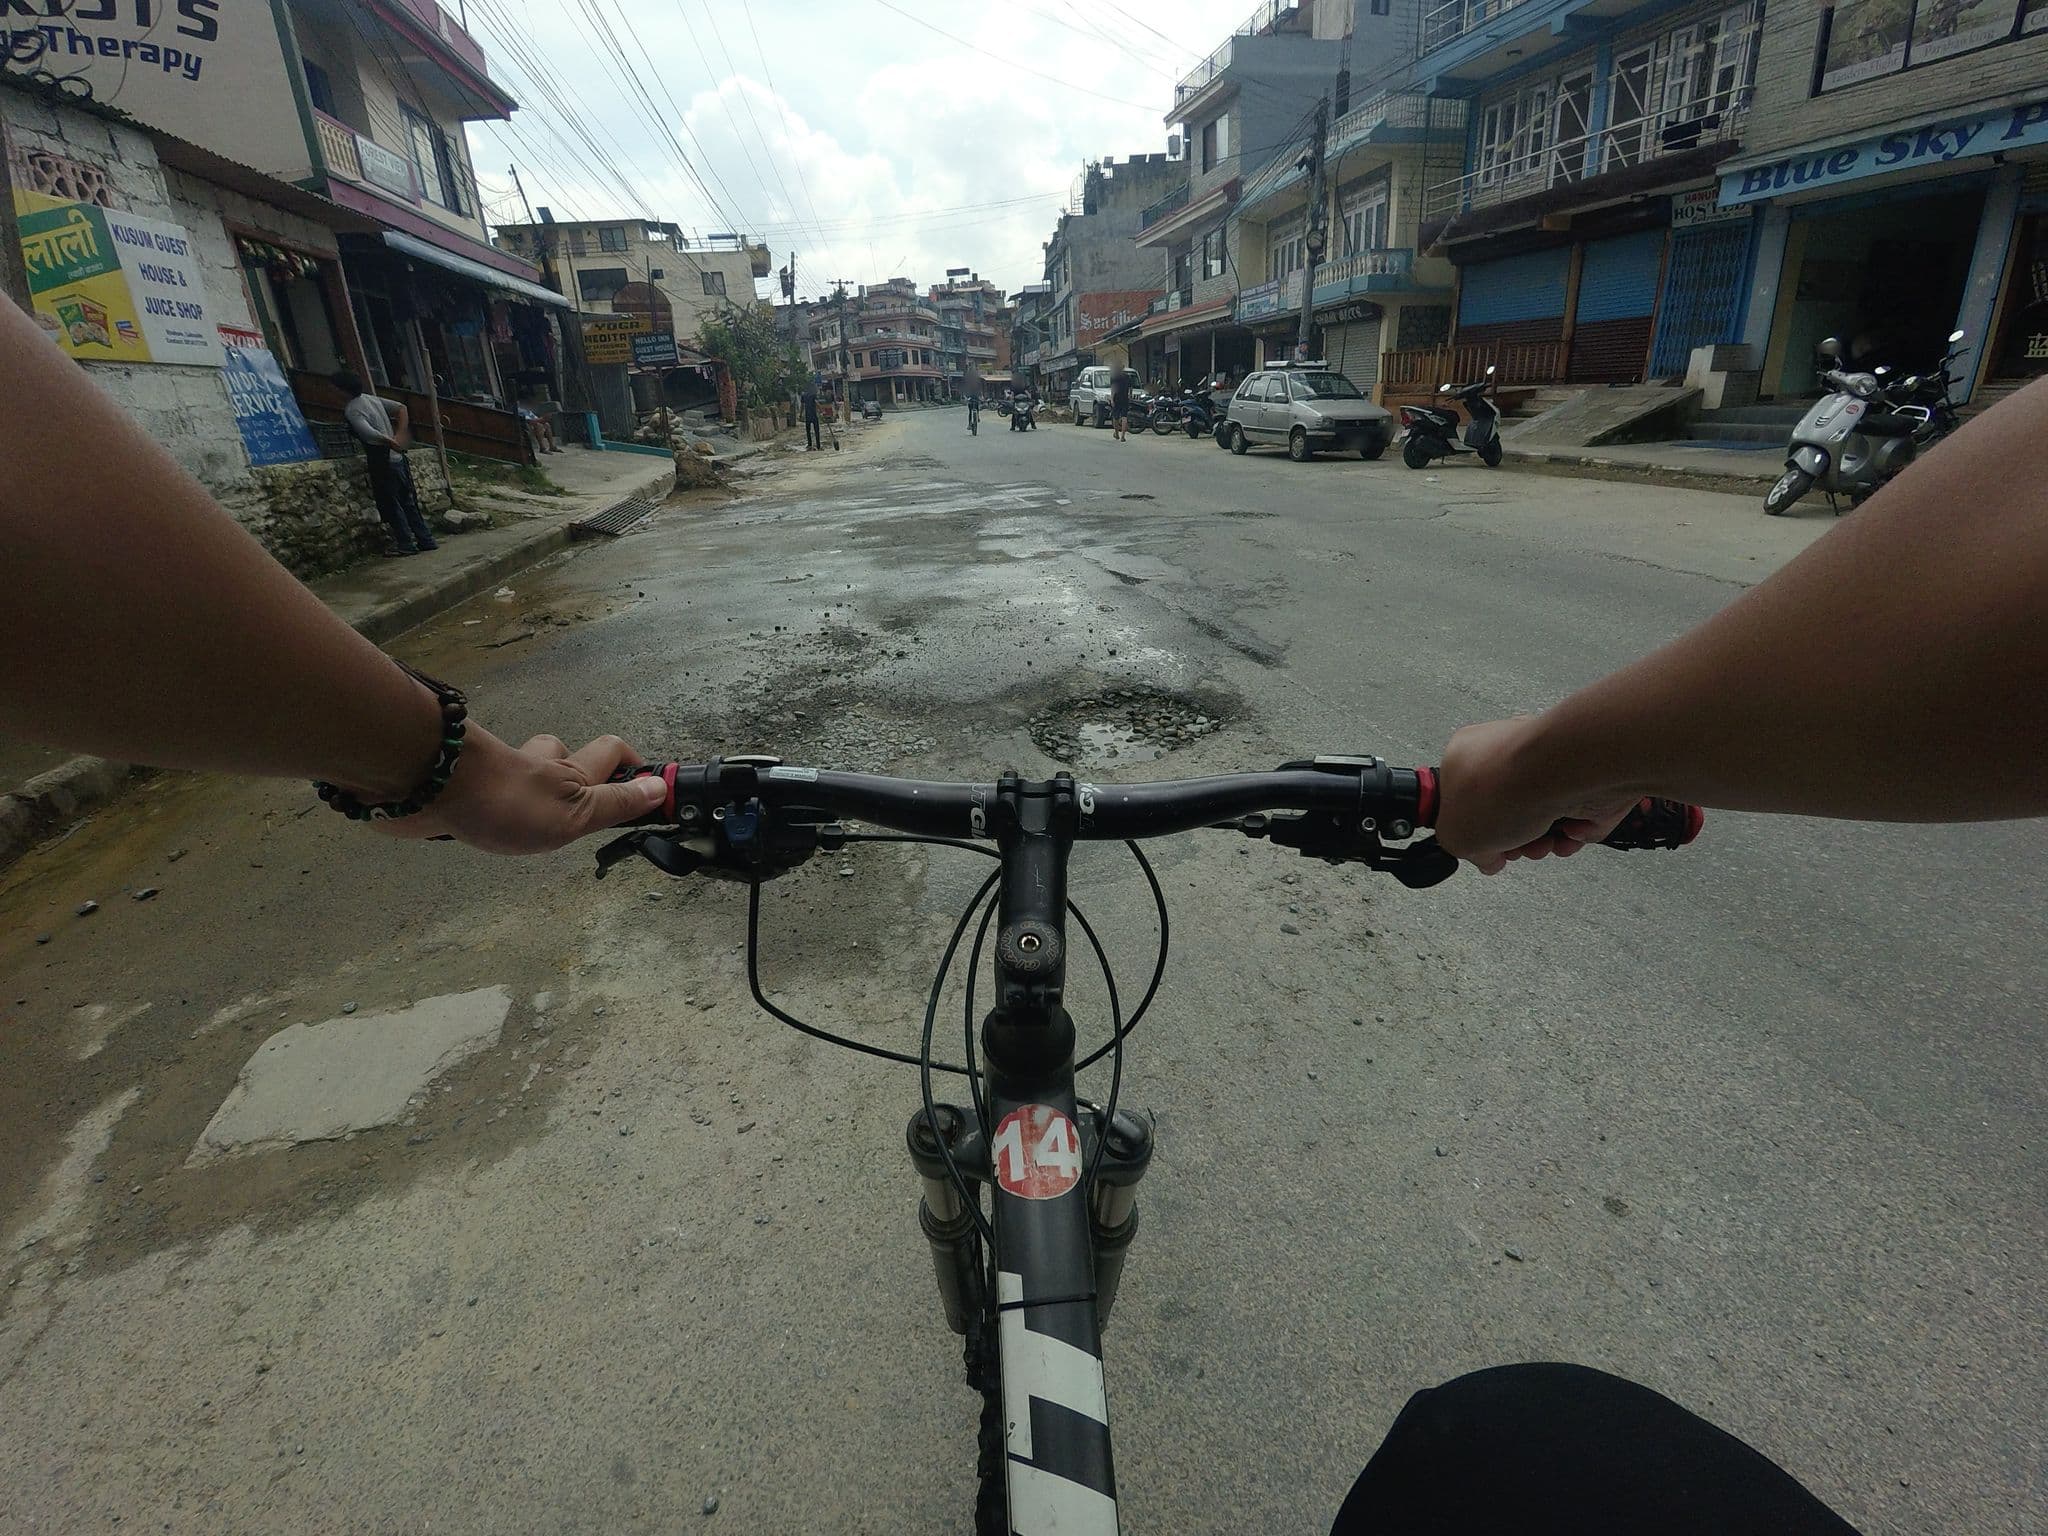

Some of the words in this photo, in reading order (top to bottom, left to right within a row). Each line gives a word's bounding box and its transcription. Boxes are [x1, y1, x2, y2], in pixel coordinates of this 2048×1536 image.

[37, 24, 203, 81] Therapy
[1738, 149, 1860, 196] Blue
[1875, 119, 1986, 167] Sky
[111, 223, 154, 250] KUSUM
[154, 234, 190, 257] GUEST
[138, 262, 178, 287] HOUSE
[179, 270, 188, 288] &
[145, 296, 177, 318] JUICE
[177, 304, 203, 321] SHOP
[995, 1116, 1079, 1182] 14
